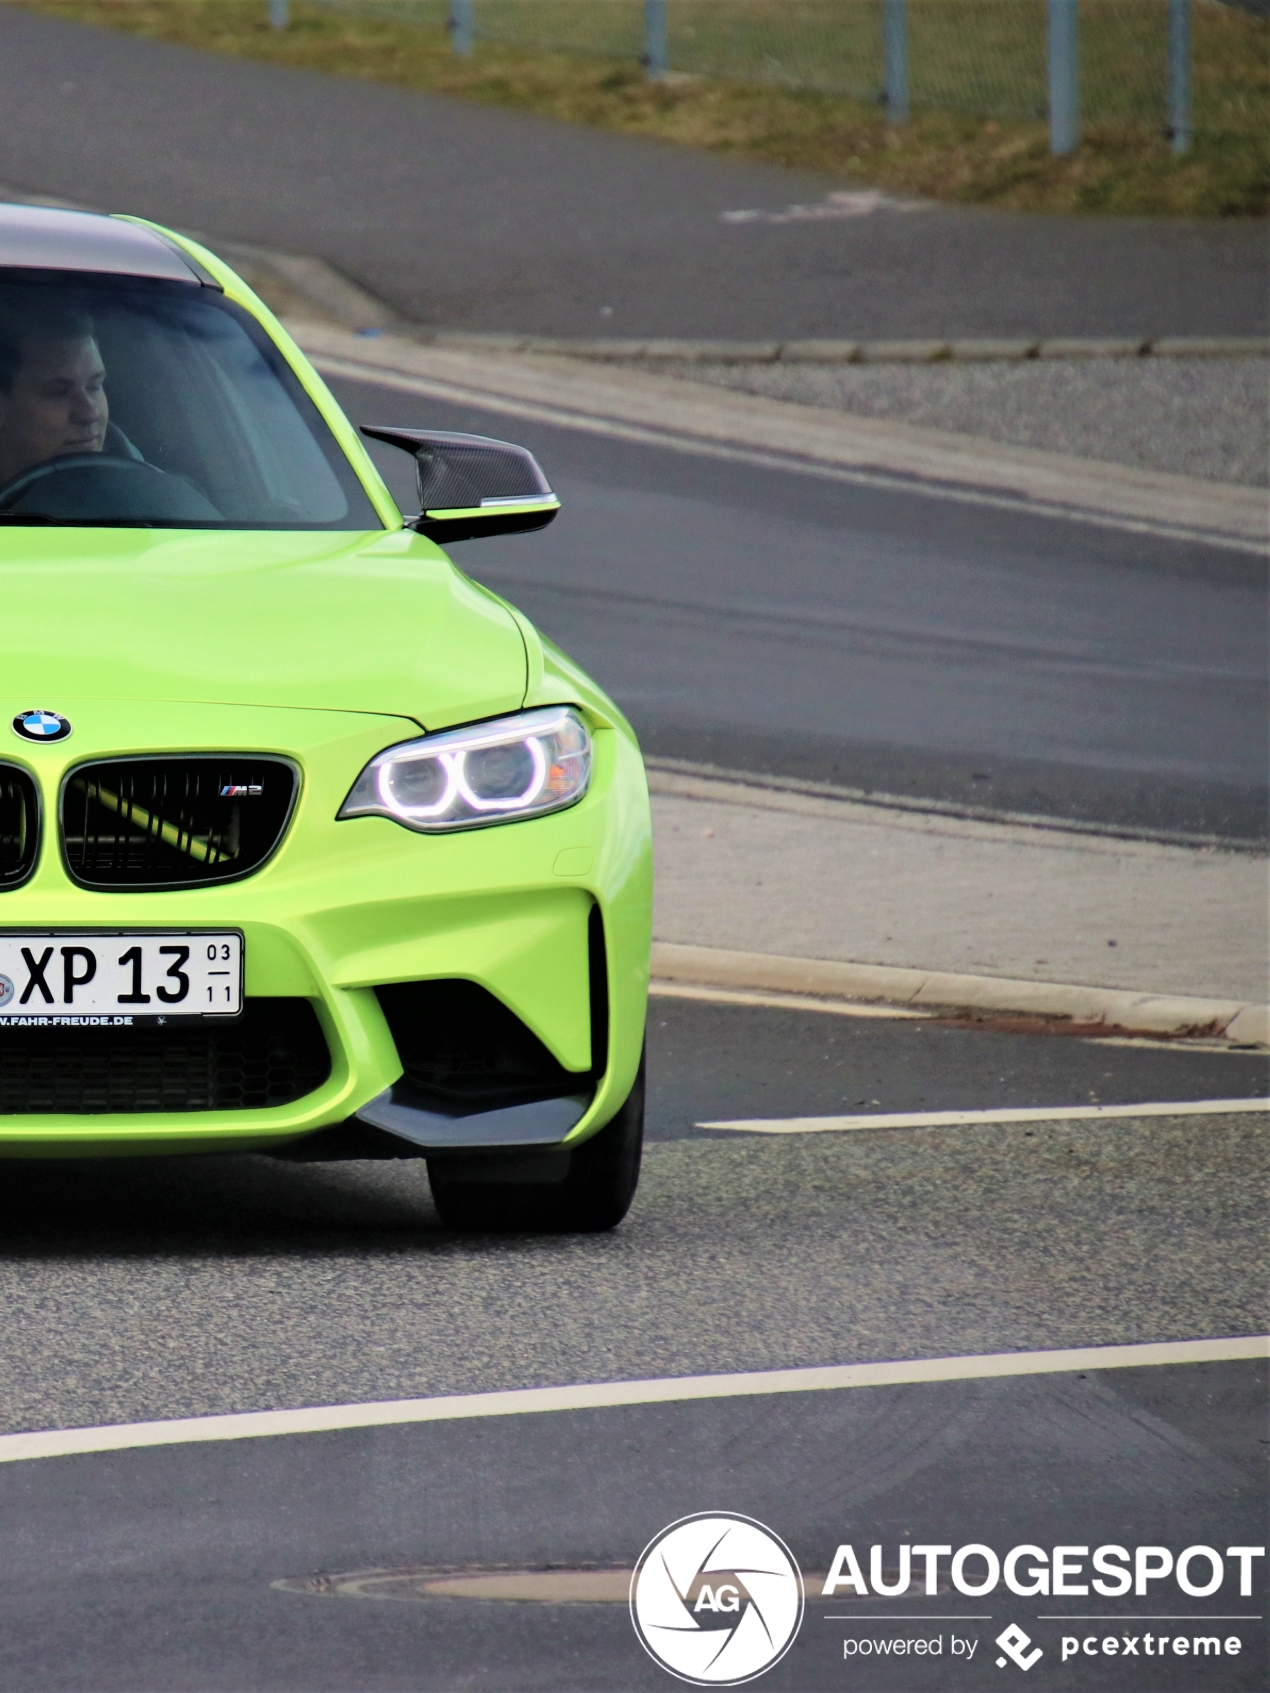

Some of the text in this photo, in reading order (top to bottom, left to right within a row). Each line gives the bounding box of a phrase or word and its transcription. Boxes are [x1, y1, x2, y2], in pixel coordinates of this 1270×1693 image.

[16, 710, 65, 720] BMW
[232, 785, 262, 796] M2
[207, 944, 231, 961] 03
[19, 945, 97, 1004] XP
[117, 944, 190, 1004] 13
[207, 985, 231, 1002] 11
